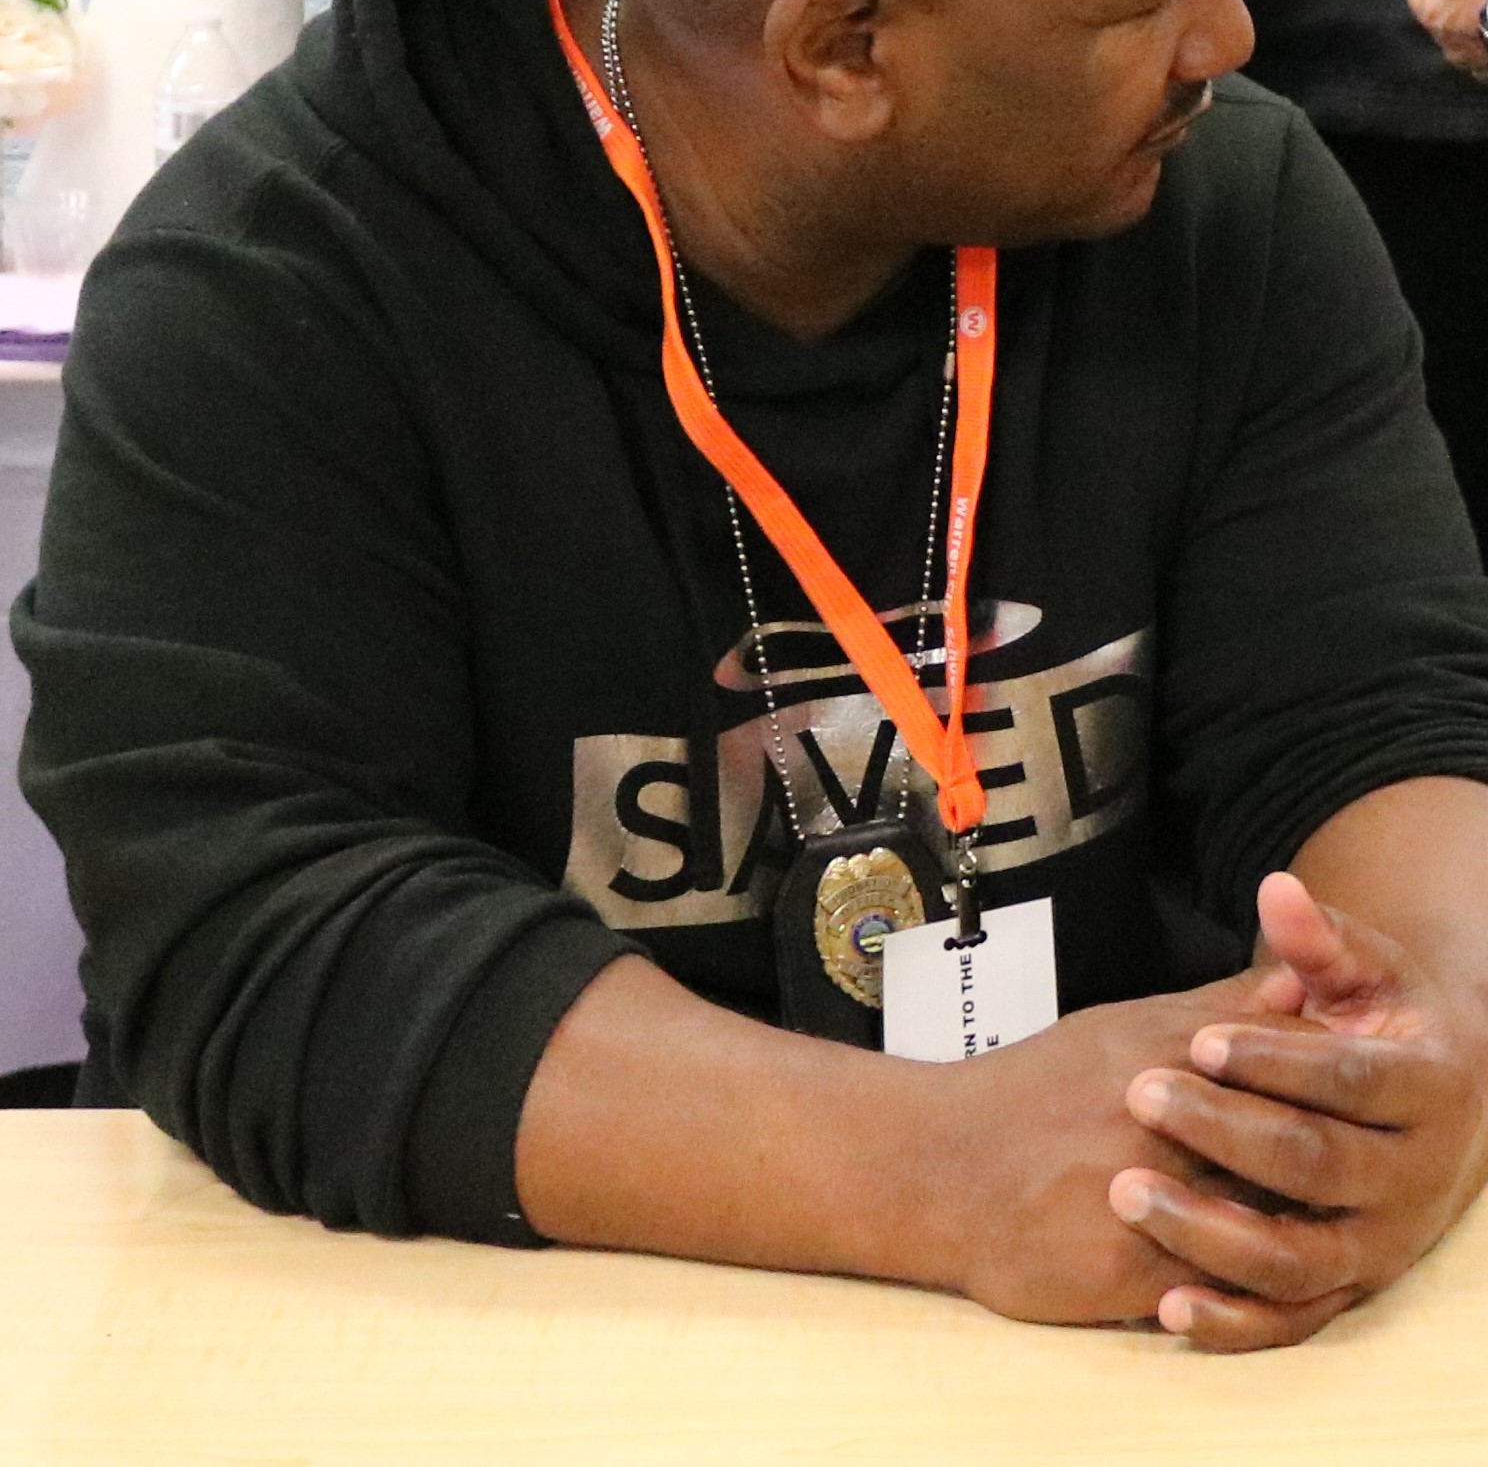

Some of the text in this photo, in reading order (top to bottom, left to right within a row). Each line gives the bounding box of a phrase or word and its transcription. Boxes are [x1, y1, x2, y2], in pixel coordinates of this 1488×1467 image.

[949, 497, 969, 577] Warren
[607, 671, 1150, 902] SAVED
[959, 953, 973, 995] THE
[961, 1000, 976, 1028] TO
